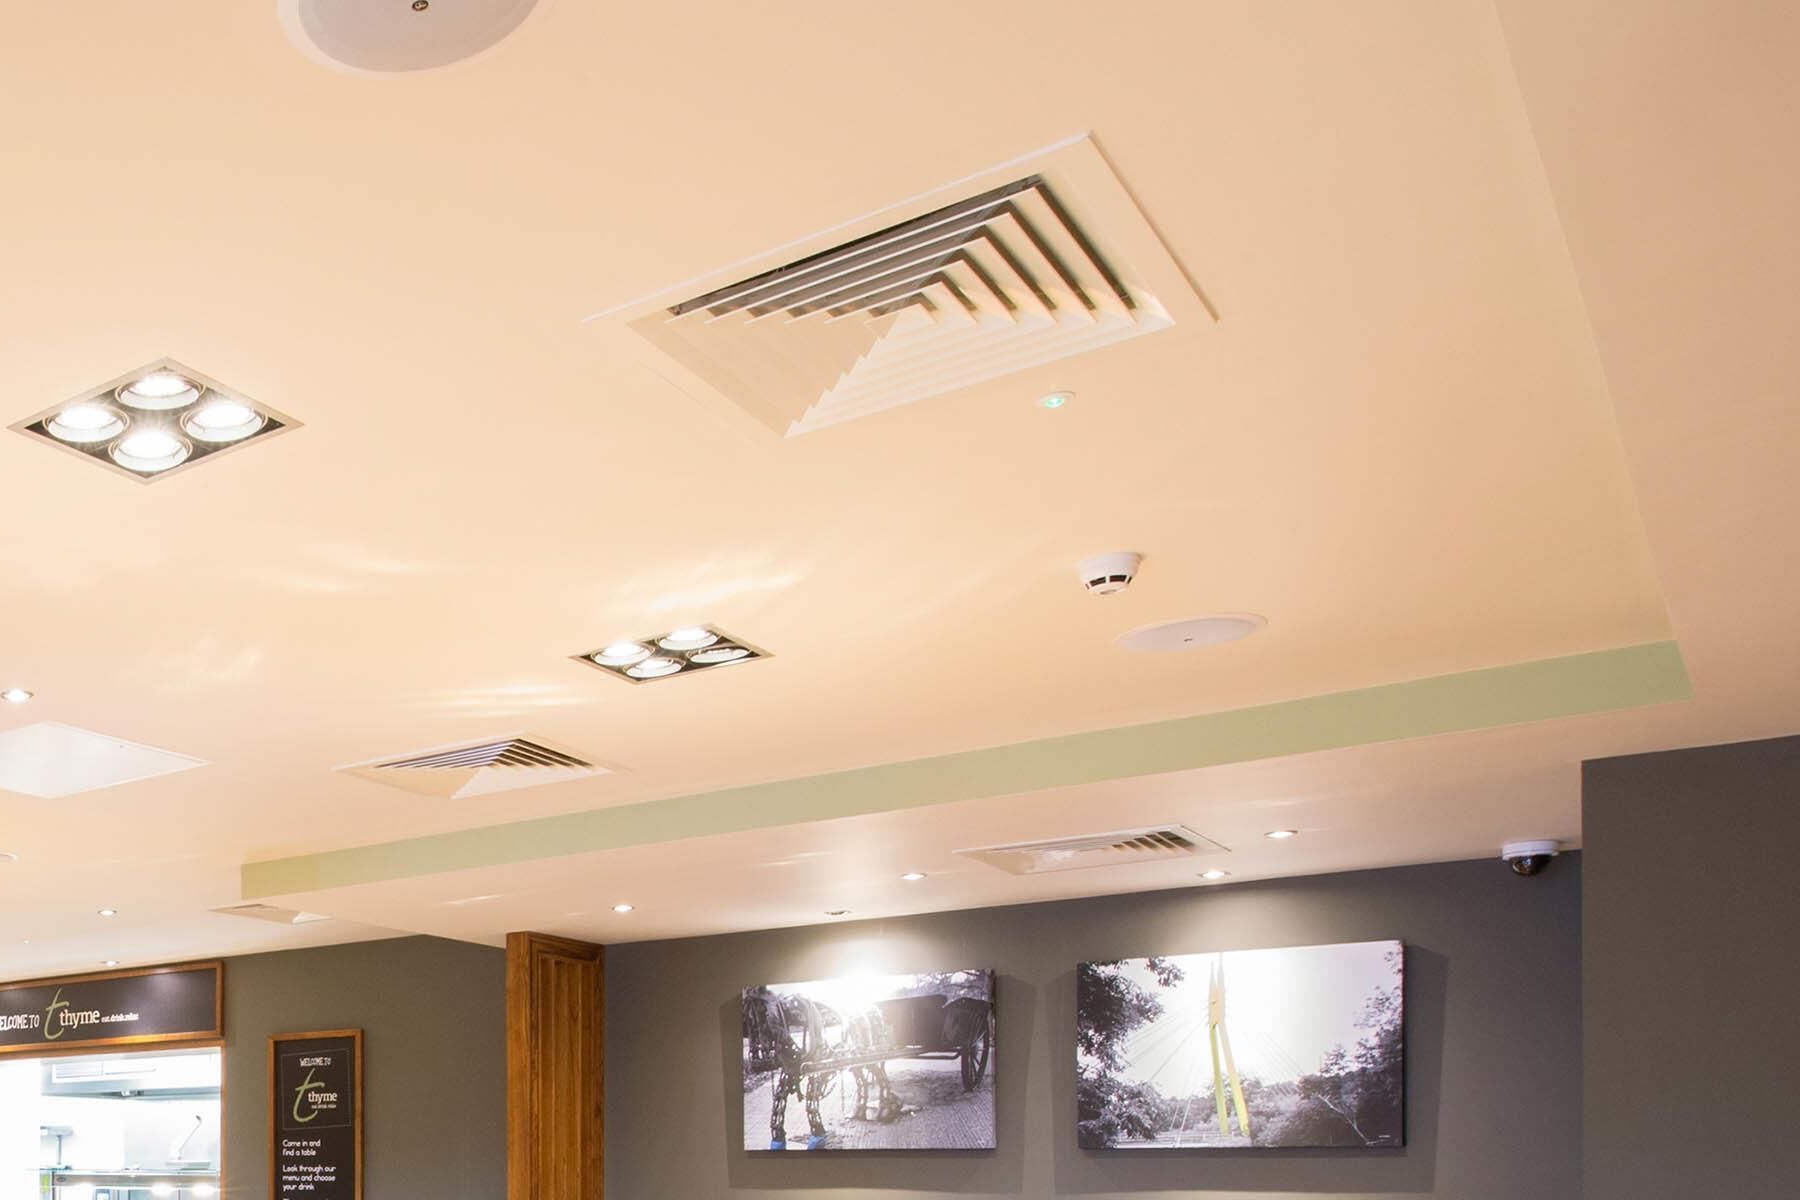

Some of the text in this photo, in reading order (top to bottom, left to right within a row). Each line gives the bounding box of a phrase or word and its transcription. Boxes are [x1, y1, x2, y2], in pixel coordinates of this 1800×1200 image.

[29, 1014, 39, 1028] TO
[59, 1009, 100, 1029] thyme
[300, 1058, 323, 1067] WELCOME
[308, 1091, 337, 1104] thyme
[283, 1139, 321, 1147] Come in and
[283, 1148, 294, 1156] find
[302, 1148, 316, 1156] table
[283, 1165, 297, 1173] Look
[299, 1165, 323, 1175] through
[314, 1174, 335, 1182] choose
[283, 1183, 315, 1192] your drink
